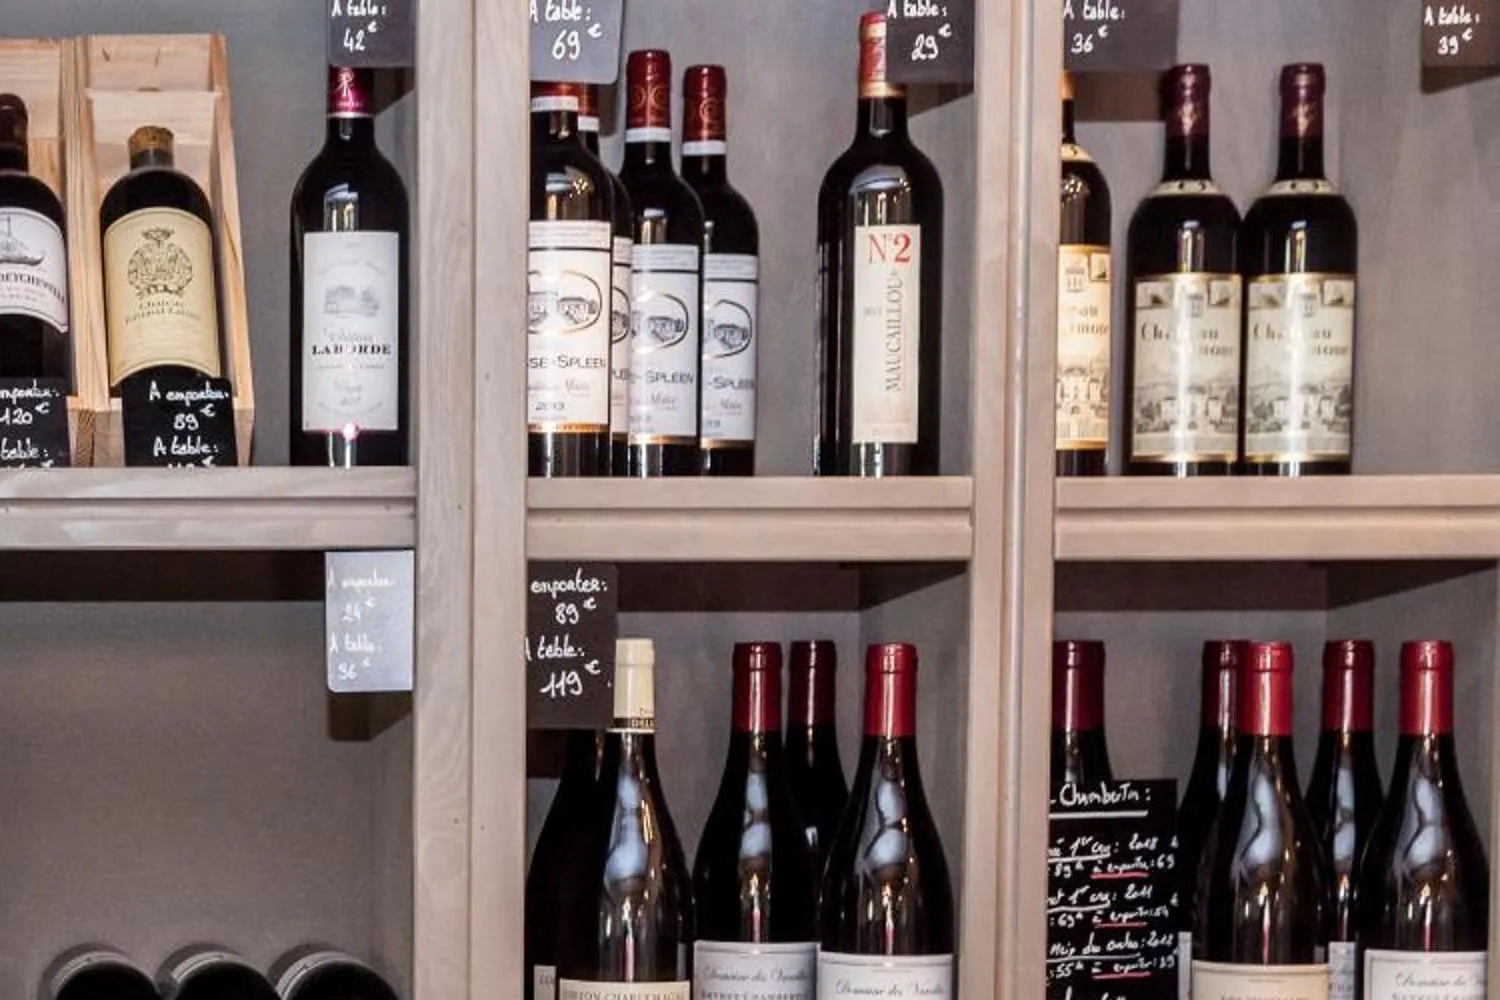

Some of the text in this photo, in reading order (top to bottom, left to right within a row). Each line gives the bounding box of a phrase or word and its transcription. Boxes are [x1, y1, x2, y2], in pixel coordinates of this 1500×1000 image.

[332, 0, 342, 17] A
[888, 0, 897, 18] A
[1063, 0, 1074, 20] A
[1424, 5, 1434, 26] A
[150, 380, 160, 401] A
[153, 436, 167, 456] A
[329, 631, 338, 654] A
[539, 660, 601, 698] 119€
